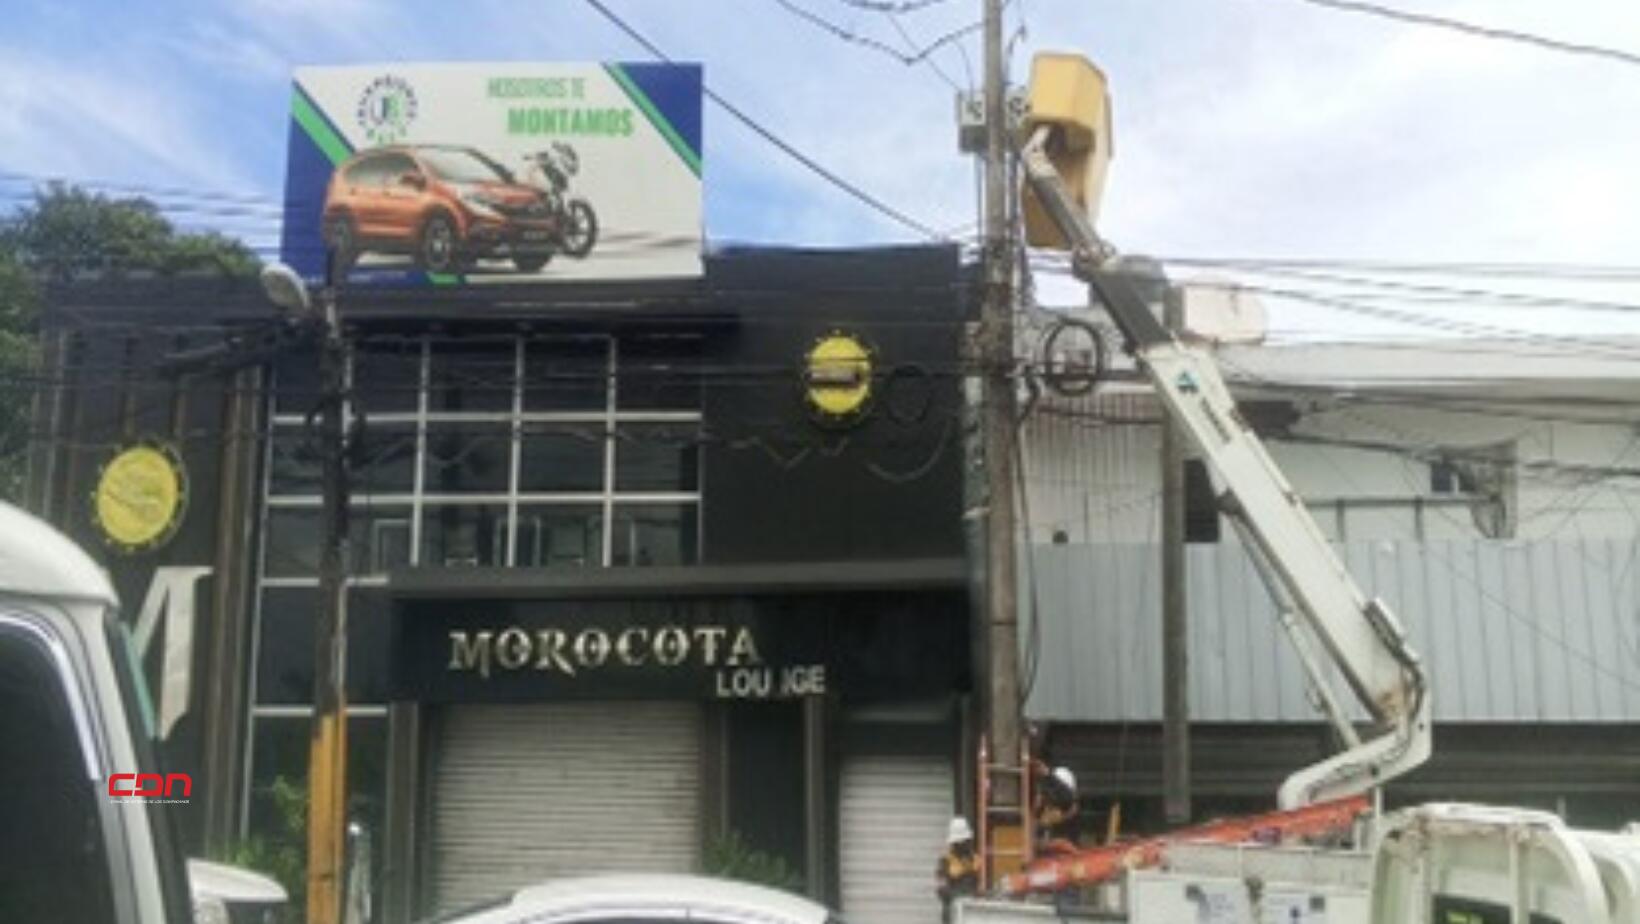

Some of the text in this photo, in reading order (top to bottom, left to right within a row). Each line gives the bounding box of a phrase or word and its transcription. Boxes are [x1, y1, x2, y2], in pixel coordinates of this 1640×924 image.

[488, 77, 567, 98] NOSOTROS
[507, 106, 634, 137] MONTAMOS
[449, 626, 760, 677] MOROCOTA
